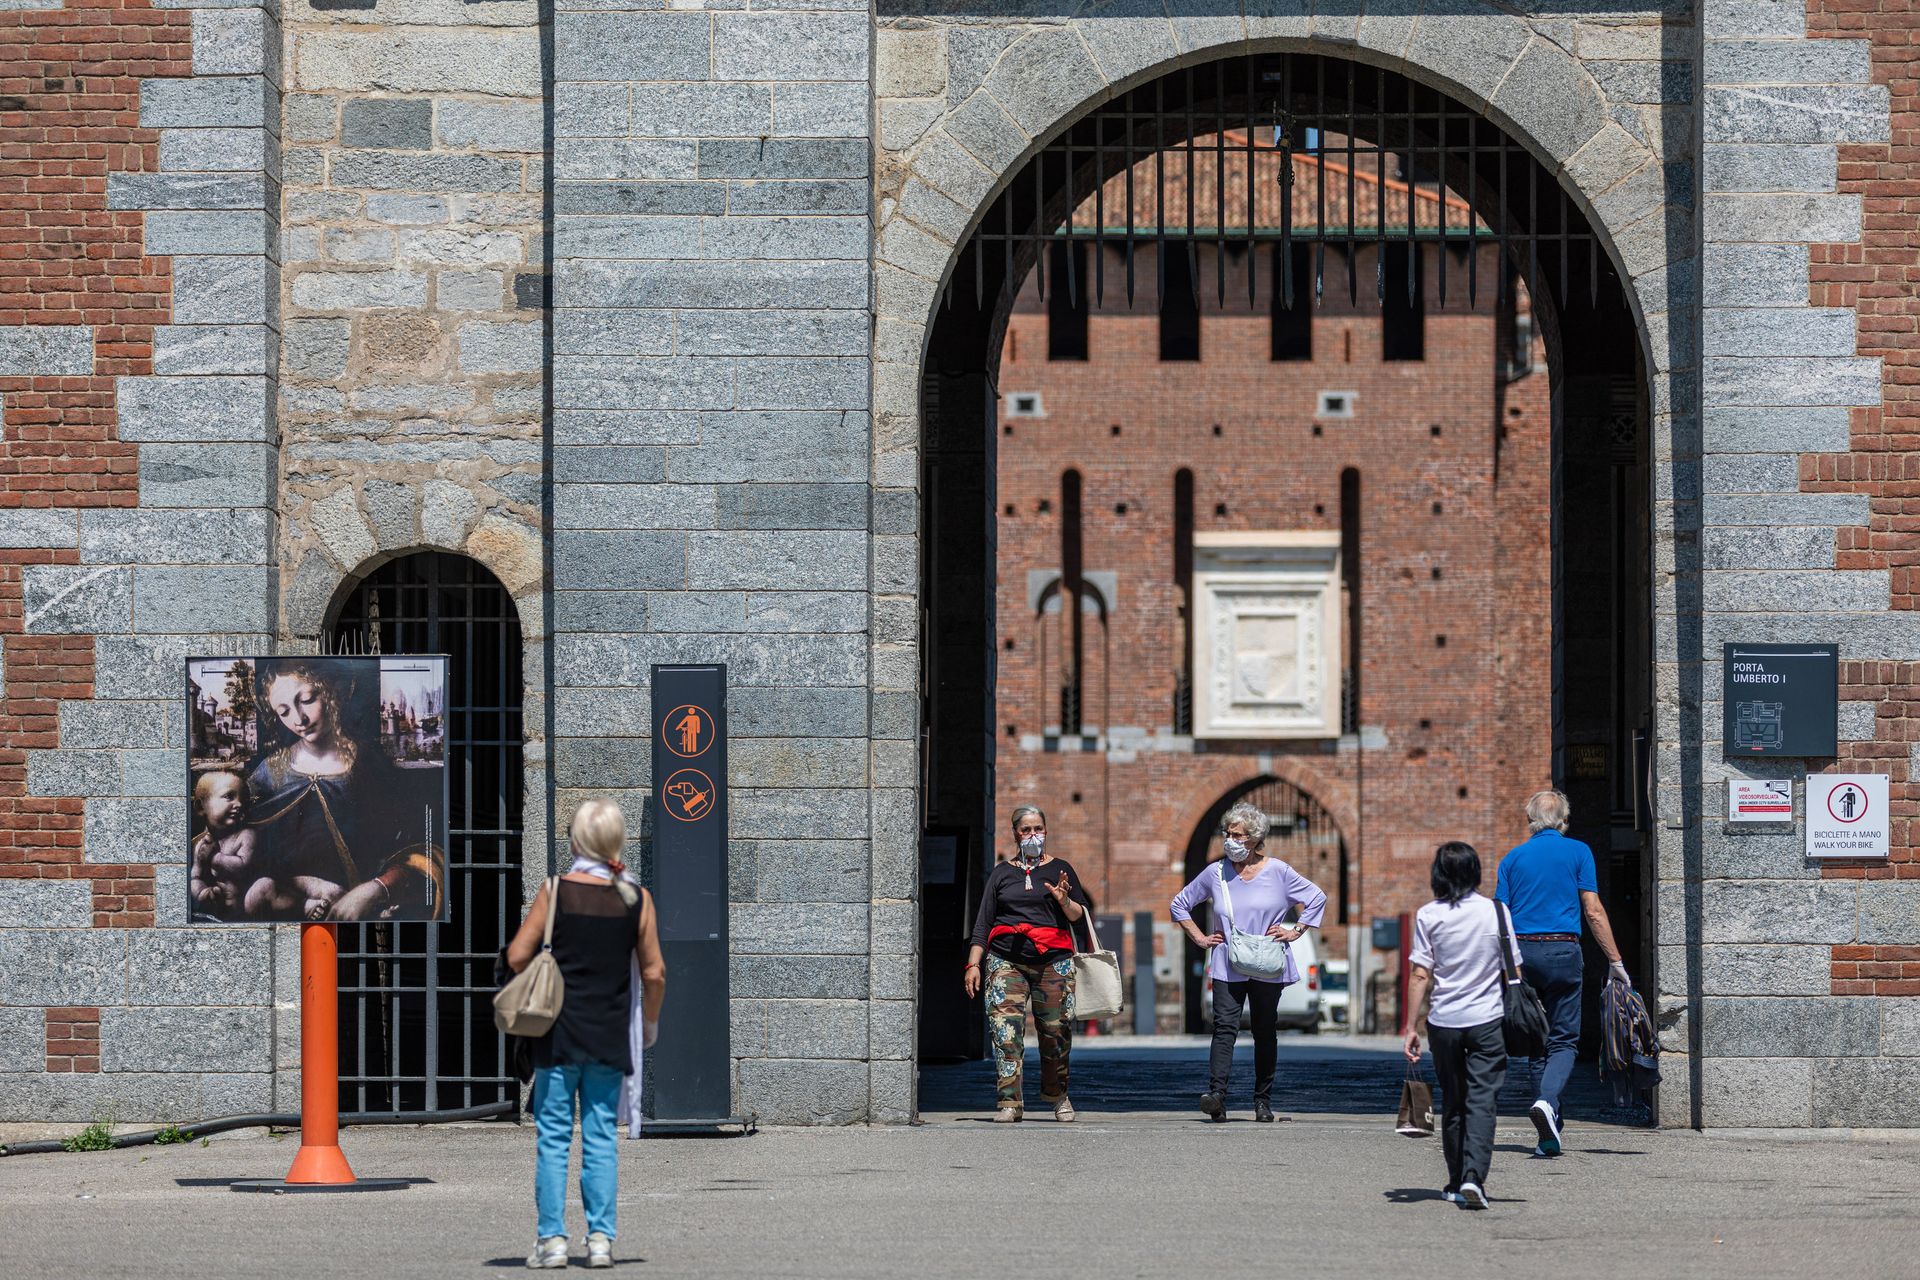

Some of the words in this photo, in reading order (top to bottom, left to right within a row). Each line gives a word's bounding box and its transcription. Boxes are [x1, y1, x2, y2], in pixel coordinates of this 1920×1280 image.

[1733, 662, 1764, 672] PORTA
[1733, 673, 1780, 683] UMBERTO
[1782, 674, 1786, 683] I
[1814, 830, 1850, 838] BICICLETTE
[1851, 830, 1857, 838] A
[1858, 830, 1881, 839] MANO
